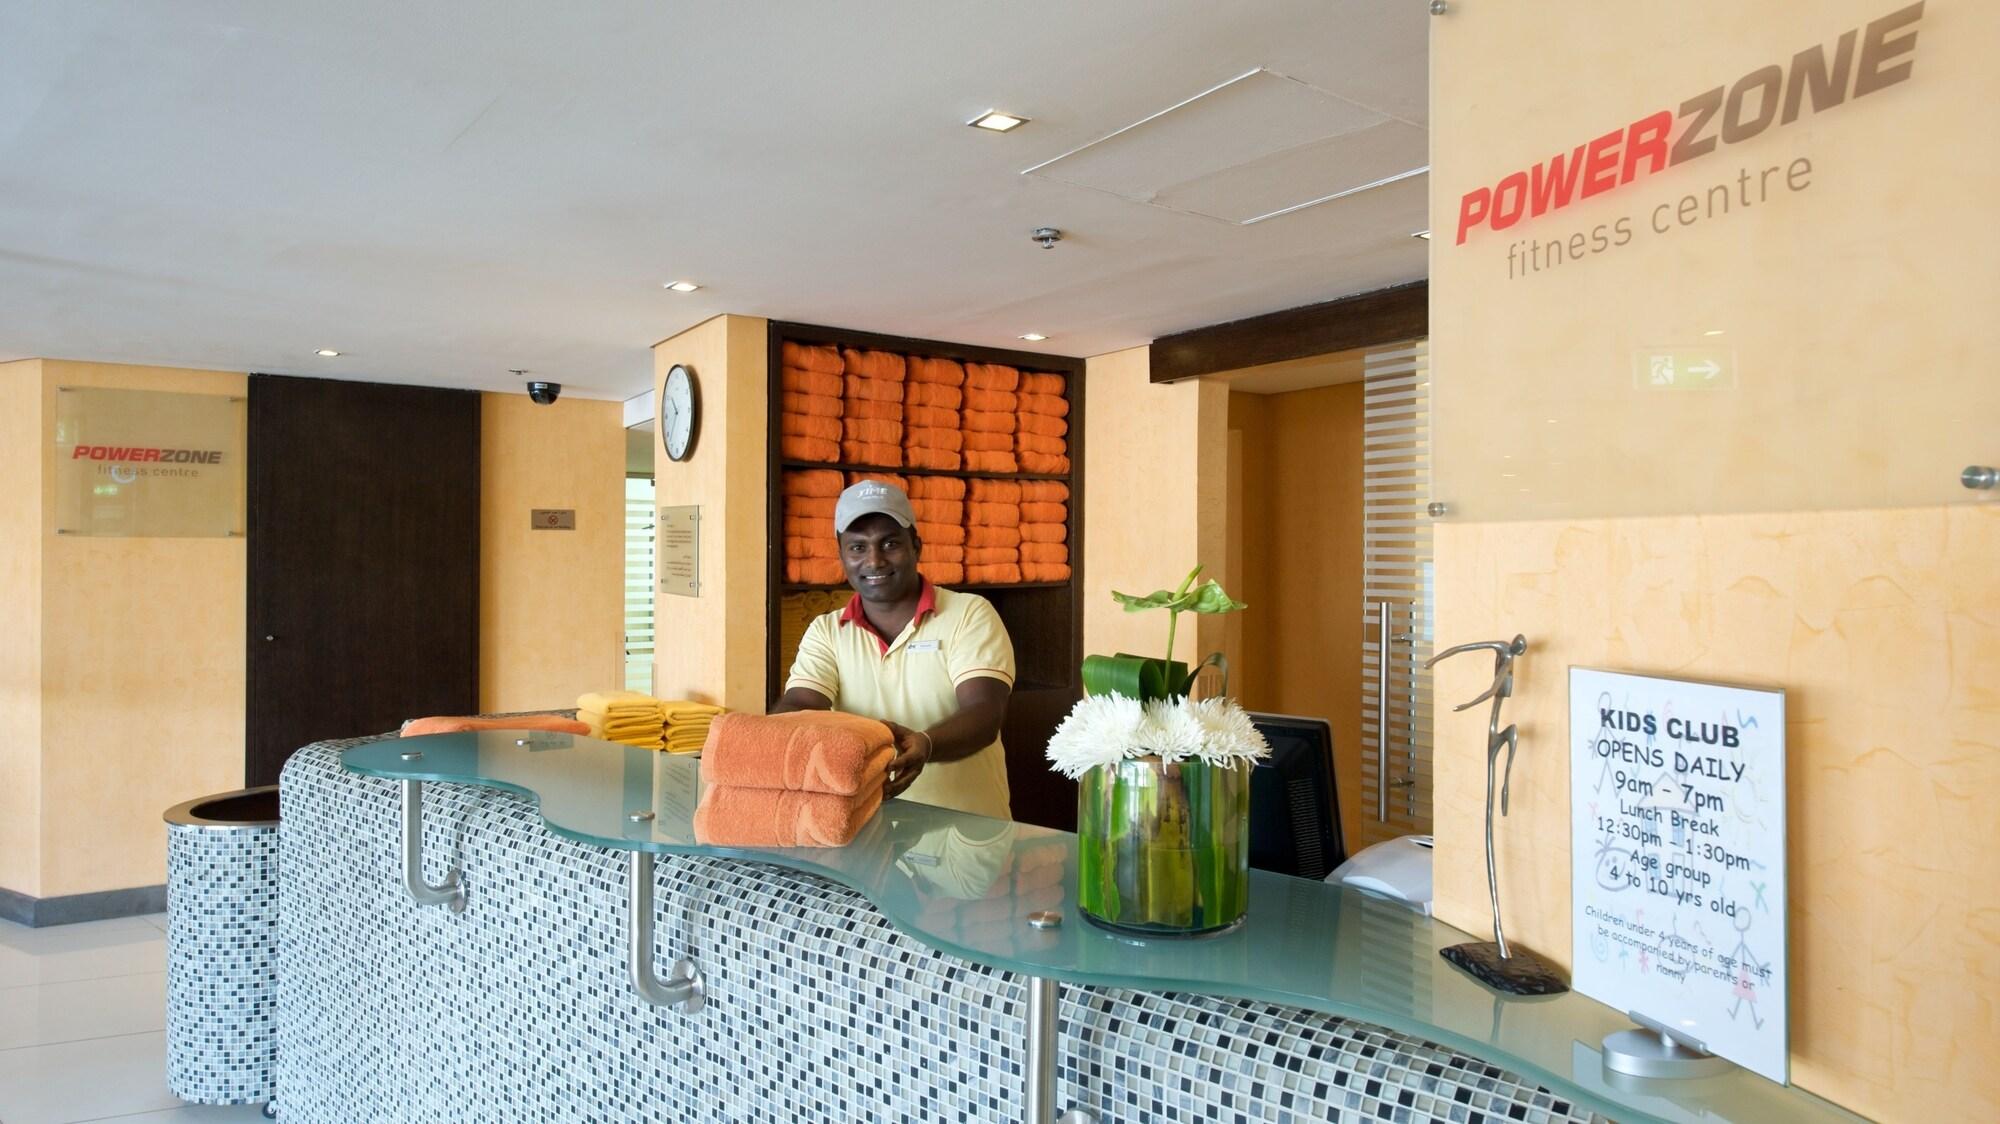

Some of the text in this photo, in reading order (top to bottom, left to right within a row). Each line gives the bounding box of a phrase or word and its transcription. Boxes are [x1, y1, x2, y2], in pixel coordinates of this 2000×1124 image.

[1456, 0, 1925, 246] POWERZONE
[1507, 157, 1812, 279] fitness centre
[72, 445, 222, 464] POWERZONE
[97, 464, 199, 477] fitness centre
[1601, 708, 1740, 748] KIDS CLUB
[1597, 739, 1745, 783] OPENS DAILY
[1615, 770, 1653, 797] 9am
[1681, 783, 1724, 813] 7pm
[1620, 798, 1719, 837] Lunch Break
[1598, 816, 1662, 847] 12:30pm
[1686, 838, 1750, 871] 1:30pm
[1630, 849, 1711, 888] Age group
[1610, 865, 1736, 917] 4 to 10 yrs old
[1585, 905, 1624, 928] Children
[1627, 921, 1655, 937] under
[1669, 935, 1698, 954] years
[1702, 947, 1714, 960] of
[1717, 954, 1738, 969] age
[1742, 962, 1773, 979] must
[1598, 924, 1755, 991] be accompanied by parents or
[1656, 964, 1686, 984] nanny
